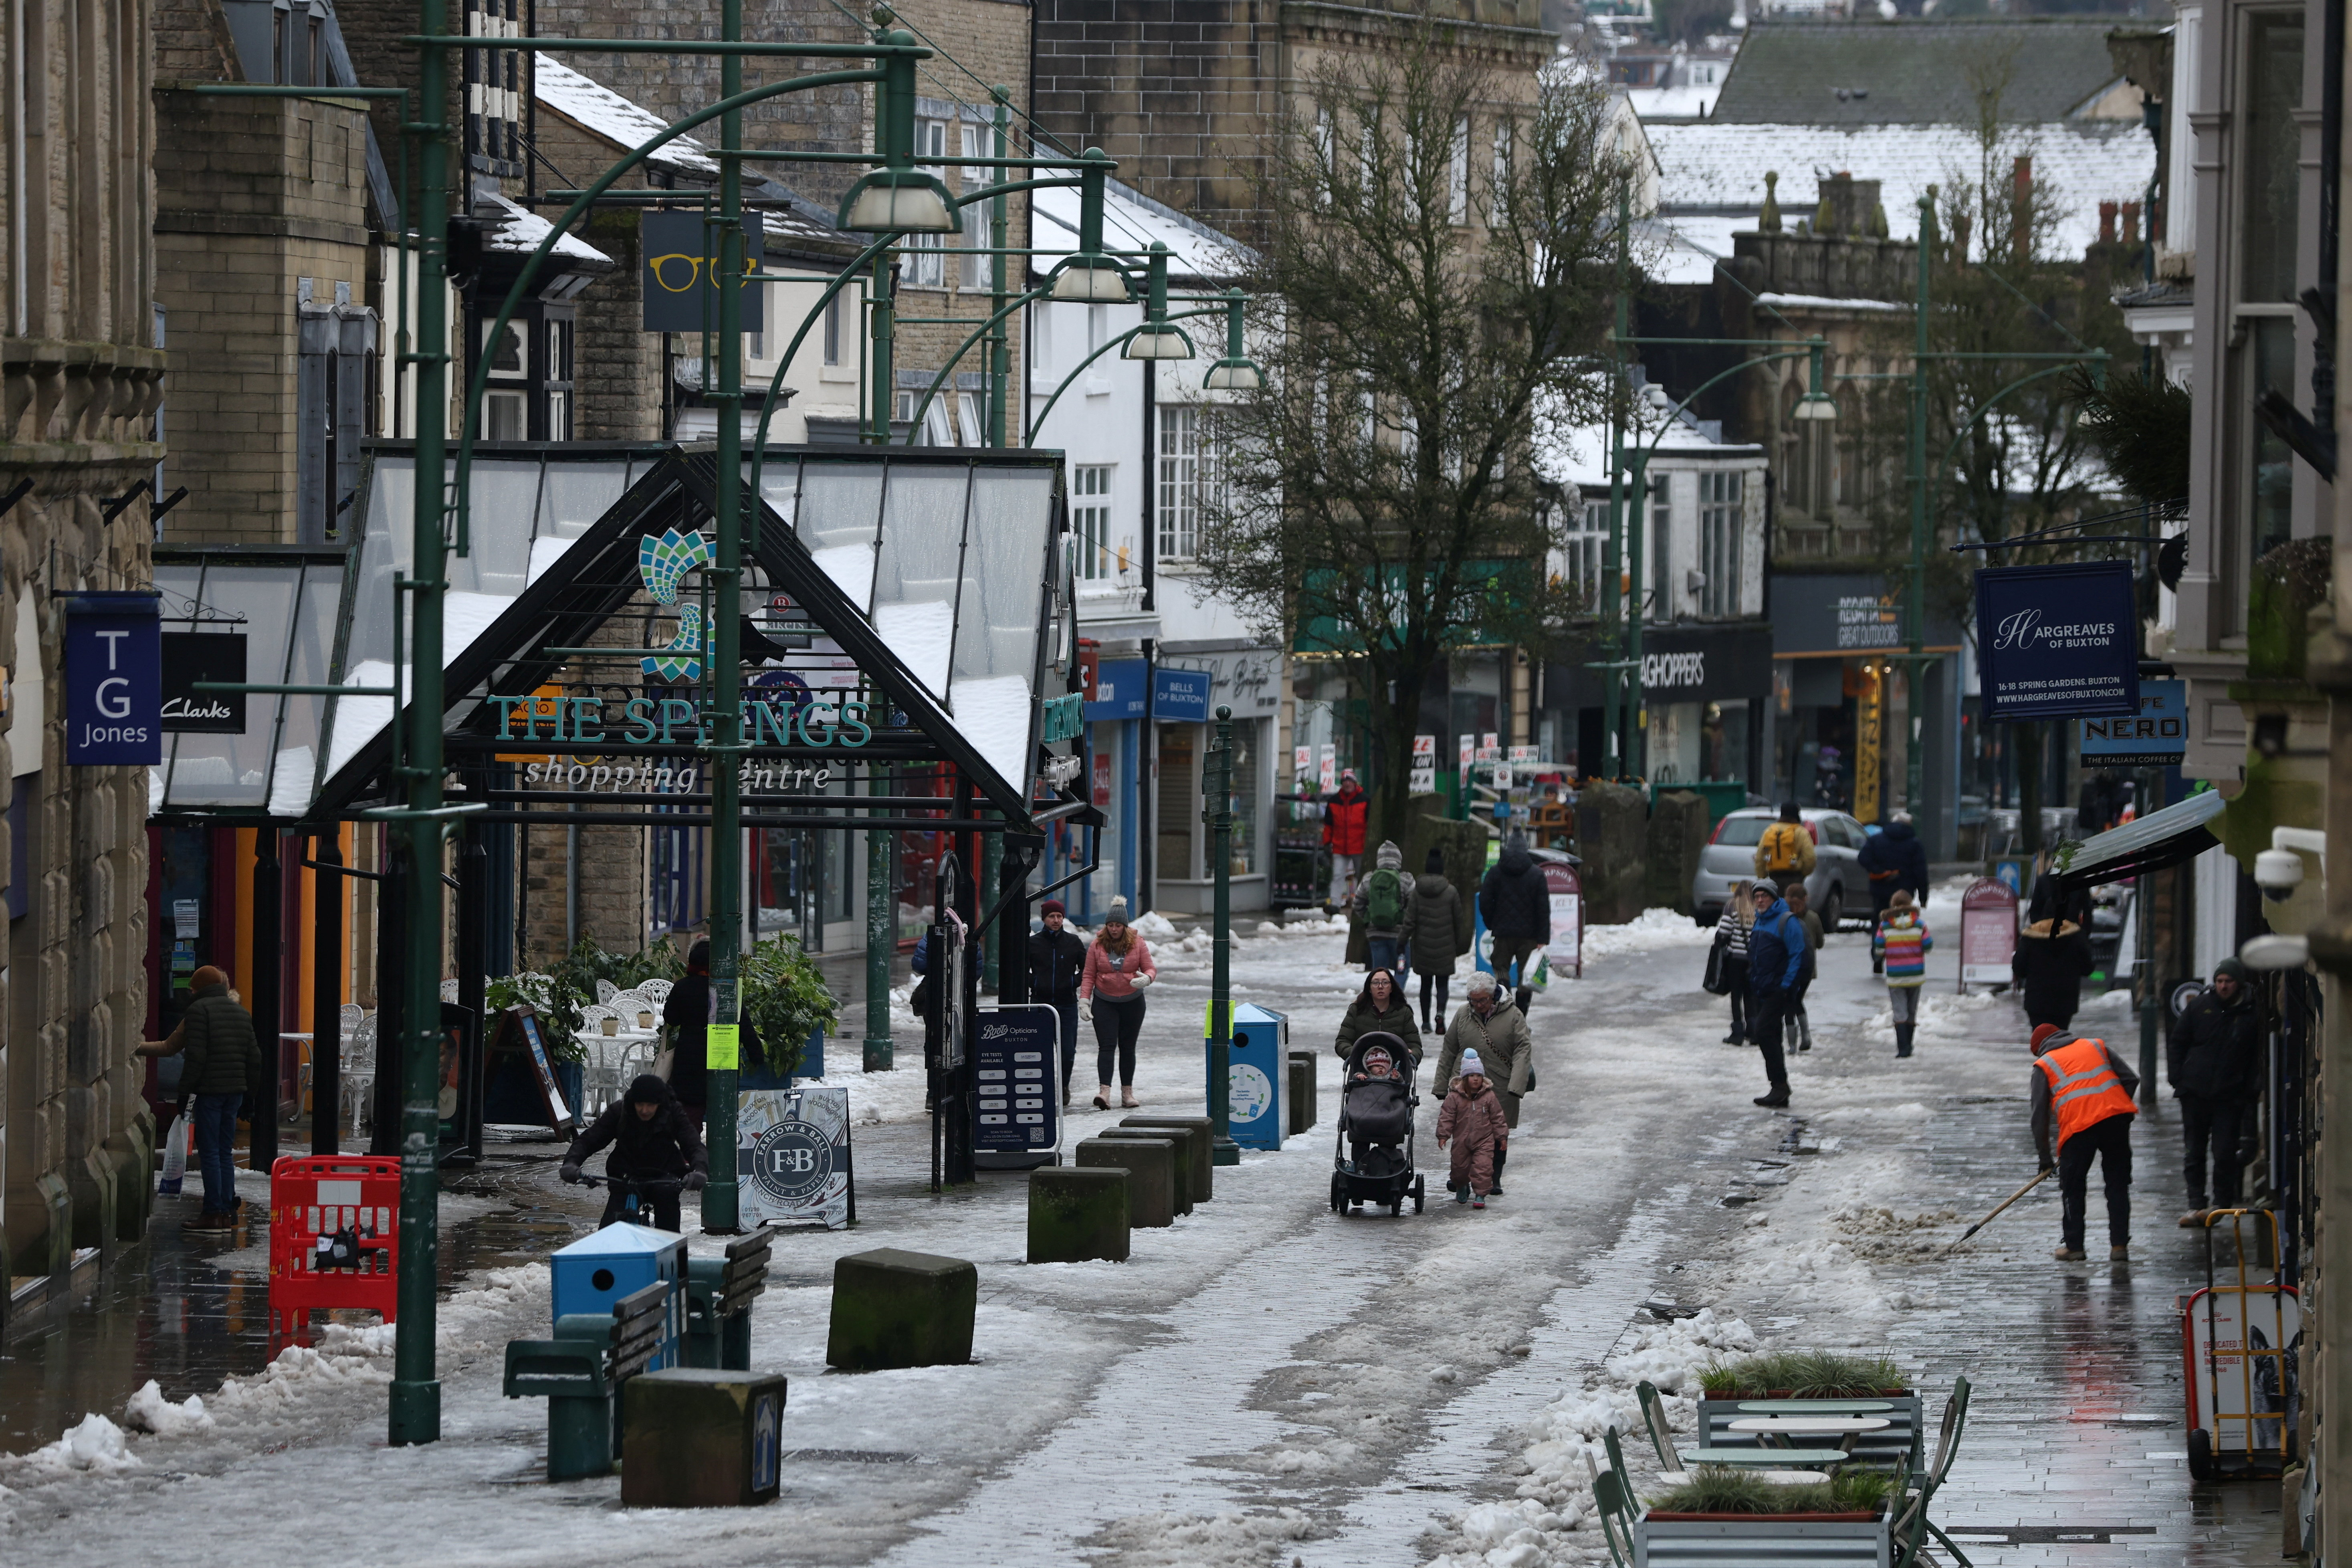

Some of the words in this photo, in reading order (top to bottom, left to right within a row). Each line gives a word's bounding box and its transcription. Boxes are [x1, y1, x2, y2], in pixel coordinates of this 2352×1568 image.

[767, 618, 804, 629] akers
[1994, 609, 2115, 649] HARGREAVES
[1837, 625, 1859, 648] GREAT
[1861, 624, 1898, 646] OUTDOORS
[2049, 640, 2062, 648] OF
[2066, 637, 2110, 647] BUXTON
[95, 631, 129, 670] T
[1624, 651, 1704, 689] AGHOPPERS
[1170, 682, 1193, 693] BELLS
[1999, 682, 2016, 691] 16-18
[2019, 680, 2047, 690] SPRING
[2088, 676, 2120, 685] BUXTON
[96, 677, 130, 718] G
[1157, 692, 1169, 701] OF
[1170, 694, 1203, 704] BUXTON
[1997, 688, 2125, 703] WWW.HARGREAVESOFBUXTON.COM
[161, 697, 231, 718] Clarks
[487, 695, 606, 742] THE
[2085, 717, 2181, 739] NERO
[79, 723, 147, 748] Jones
[1485, 736, 1497, 748] SALE
[1297, 749, 1310, 763] SALE
[1322, 759, 1334, 774] MUST
[525, 755, 697, 795] shopping
[739, 765, 832, 789] entre
[1094, 768, 1109, 789] SALE
[1544, 869, 1573, 883] MPSON
[981, 1024, 1009, 1040] Boots
[743, 1096, 766, 1114] BUXTON
[743, 1099, 779, 1125] WOODWORKS
[807, 1099, 844, 1123] WOODWORKS
[757, 1124, 795, 1155] FARROW
[809, 1128, 828, 1154] BALL
[772, 1148, 814, 1172] F&B
[751, 1179, 775, 1203] BENCH
[762, 1175, 786, 1195] PAINT
[801, 1172, 825, 1194] PAPER
[2204, 1340, 2236, 1348] DEICATED
[2205, 1357, 2241, 1365] INREDIBLE
